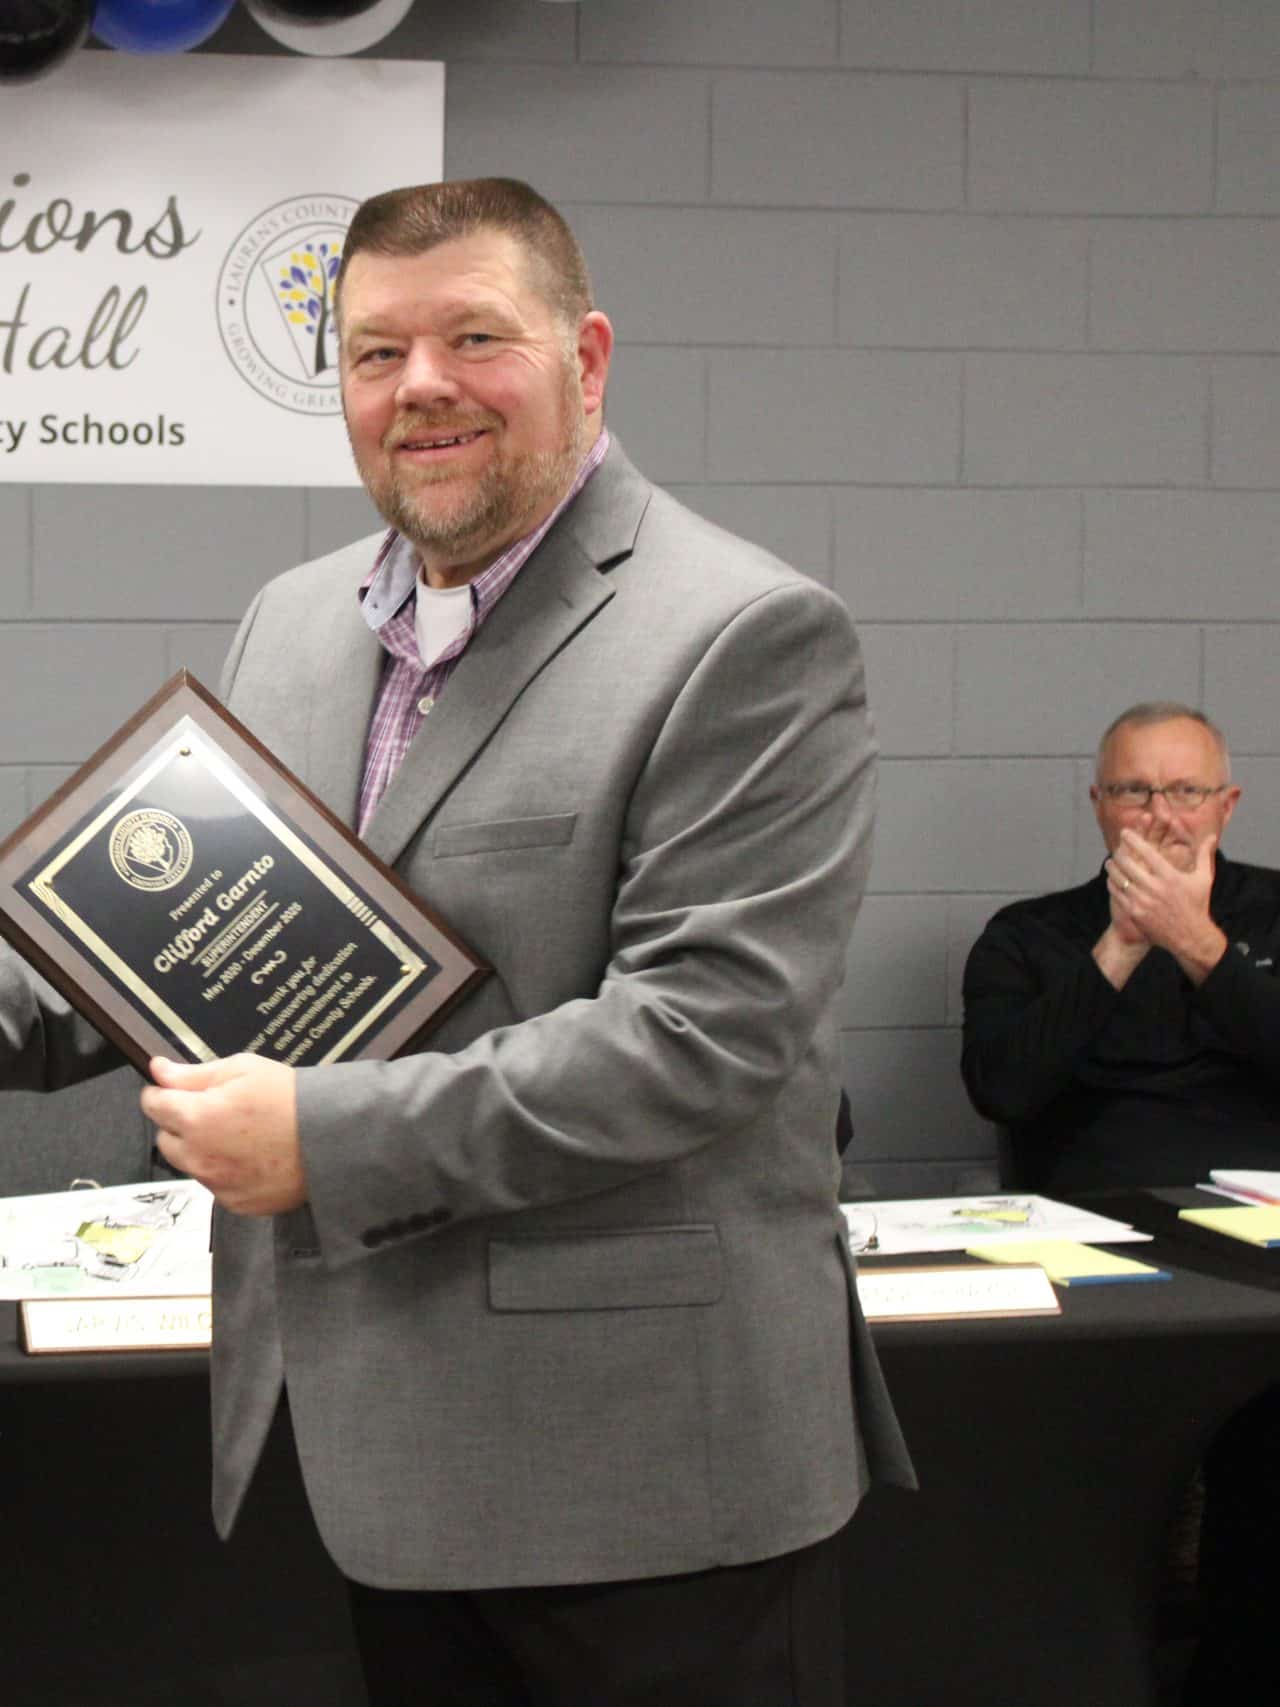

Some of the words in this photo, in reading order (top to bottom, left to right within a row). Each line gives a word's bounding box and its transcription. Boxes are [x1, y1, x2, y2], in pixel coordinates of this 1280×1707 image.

[226, 215, 279, 292] LAURENS
[282, 203, 354, 223] COUNT
[228, 322, 289, 398] GROWING
[293, 392, 340, 408] GREA
[39, 413, 186, 446] Schools
[154, 906, 220, 973] Clifford
[215, 855, 275, 911] Garnto
[169, 878, 214, 921] Presented
[210, 869, 223, 880] to
[200, 899, 269, 968] SUPERINTENDENT
[201, 980, 225, 1001] May
[241, 921, 285, 961] December
[256, 985, 290, 1015] Thank
[285, 969, 306, 990] you
[312, 942, 358, 987] dedication
[308, 1007, 345, 1039] County
